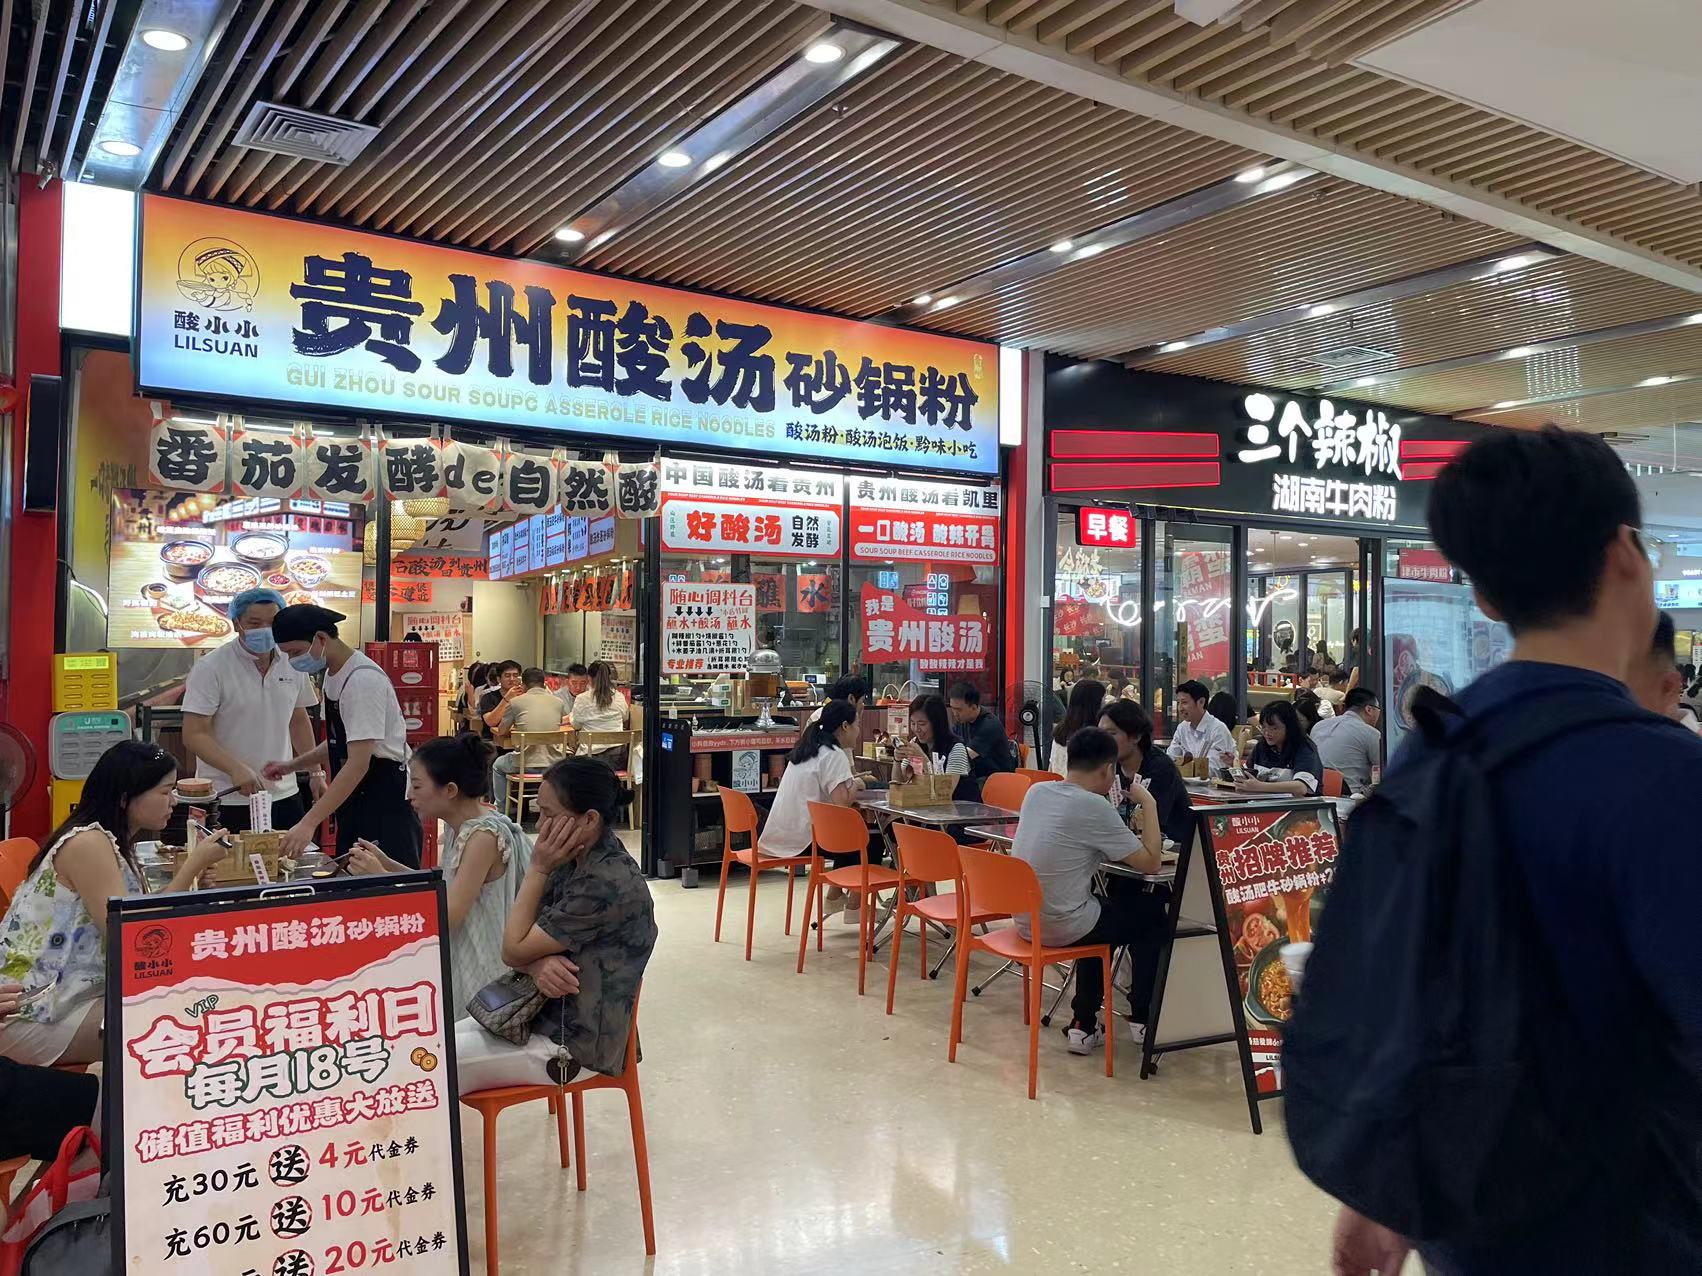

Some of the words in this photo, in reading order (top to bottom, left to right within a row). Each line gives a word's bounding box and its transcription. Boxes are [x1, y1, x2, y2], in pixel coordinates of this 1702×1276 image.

[174, 310, 259, 338] 酸小小
[174, 334, 258, 358] LILSUAN
[289, 252, 979, 431] 贵州酸汤砂锅粉
[287, 363, 326, 388] GUI
[334, 368, 396, 395] ZHOU
[403, 378, 461, 403] SOUR
[545, 393, 647, 425] ASSEROLE
[651, 404, 693, 430] RICE
[697, 411, 776, 438] NOODLES
[1238, 393, 1402, 480] 三个辣椒
[666, 462, 835, 497] 中国酸汤看贵州
[857, 480, 999, 509] 贵州酸汤看凯里
[1272, 473, 1397, 521] 湖南牛肉粉
[686, 510, 782, 546] 好酸汤
[791, 532, 819, 548] 发酵
[792, 515, 819, 531] 自然
[858, 519, 925, 544] 一口酸汤
[1086, 512, 1129, 543] 早餐
[880, 547, 896, 555] SOUP
[966, 552, 993, 560] NOODLES
[669, 588, 753, 606] 随心调料台
[865, 596, 894, 616] 我是
[867, 619, 983, 653] 贵州酸汤
[1216, 850, 1236, 885] 贵州
[1232, 831, 1339, 880] 招牌推荐
[191, 912, 425, 961] 贵州酸汤砂锅粉
[134, 958, 173, 971] 酸小小
[134, 968, 174, 979] LILSUAN
[184, 994, 219, 1019] VIP
[128, 981, 437, 1079] 会员福利日
[186, 1035, 391, 1110] 每月18号
[136, 1080, 438, 1163] 储值福利优惠大放送
[162, 1161, 259, 1207] 充30元
[270, 1144, 309, 1186] 送
[163, 1214, 261, 1260] 充60元
[271, 1195, 311, 1238] 送
